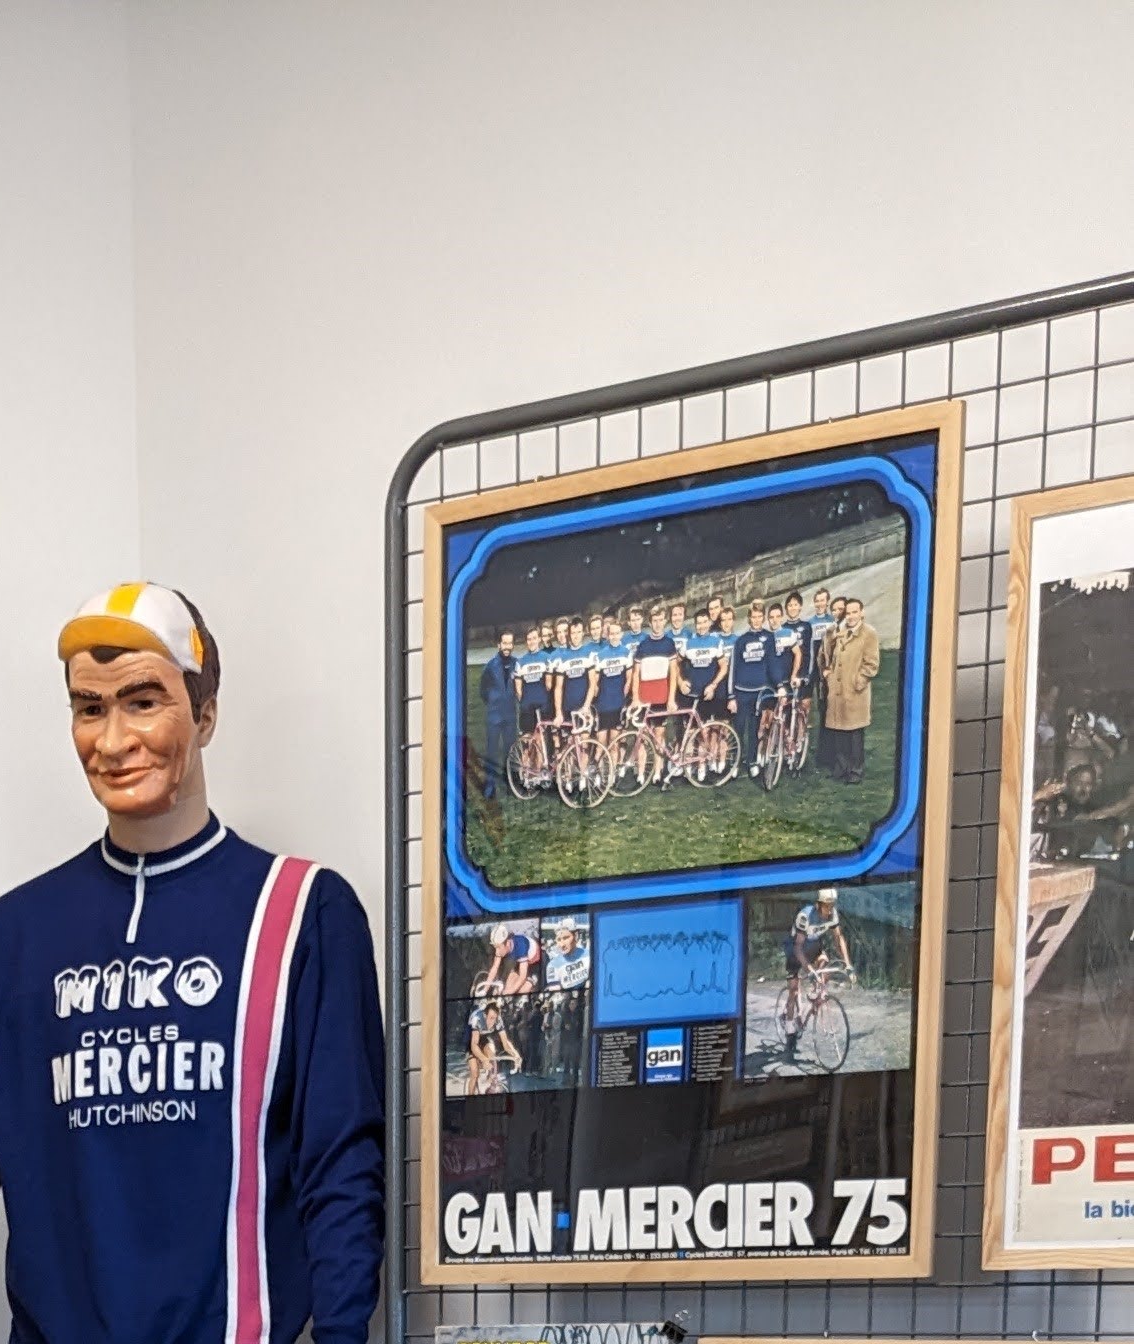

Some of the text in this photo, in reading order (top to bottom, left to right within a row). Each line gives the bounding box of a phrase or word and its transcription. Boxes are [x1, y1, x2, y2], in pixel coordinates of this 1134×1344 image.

[54, 956, 222, 1018] MIKO
[80, 1025, 179, 1047] CYCLES
[647, 1048, 681, 1066] gan
[51, 1041, 225, 1104] MERCIER
[68, 1100, 196, 1129] HUTCHINSON
[444, 1178, 908, 1255] GAN MERCIER 75
[1085, 1200, 1134, 1219] la bi
[785, 1248, 808, 1256] Grande
